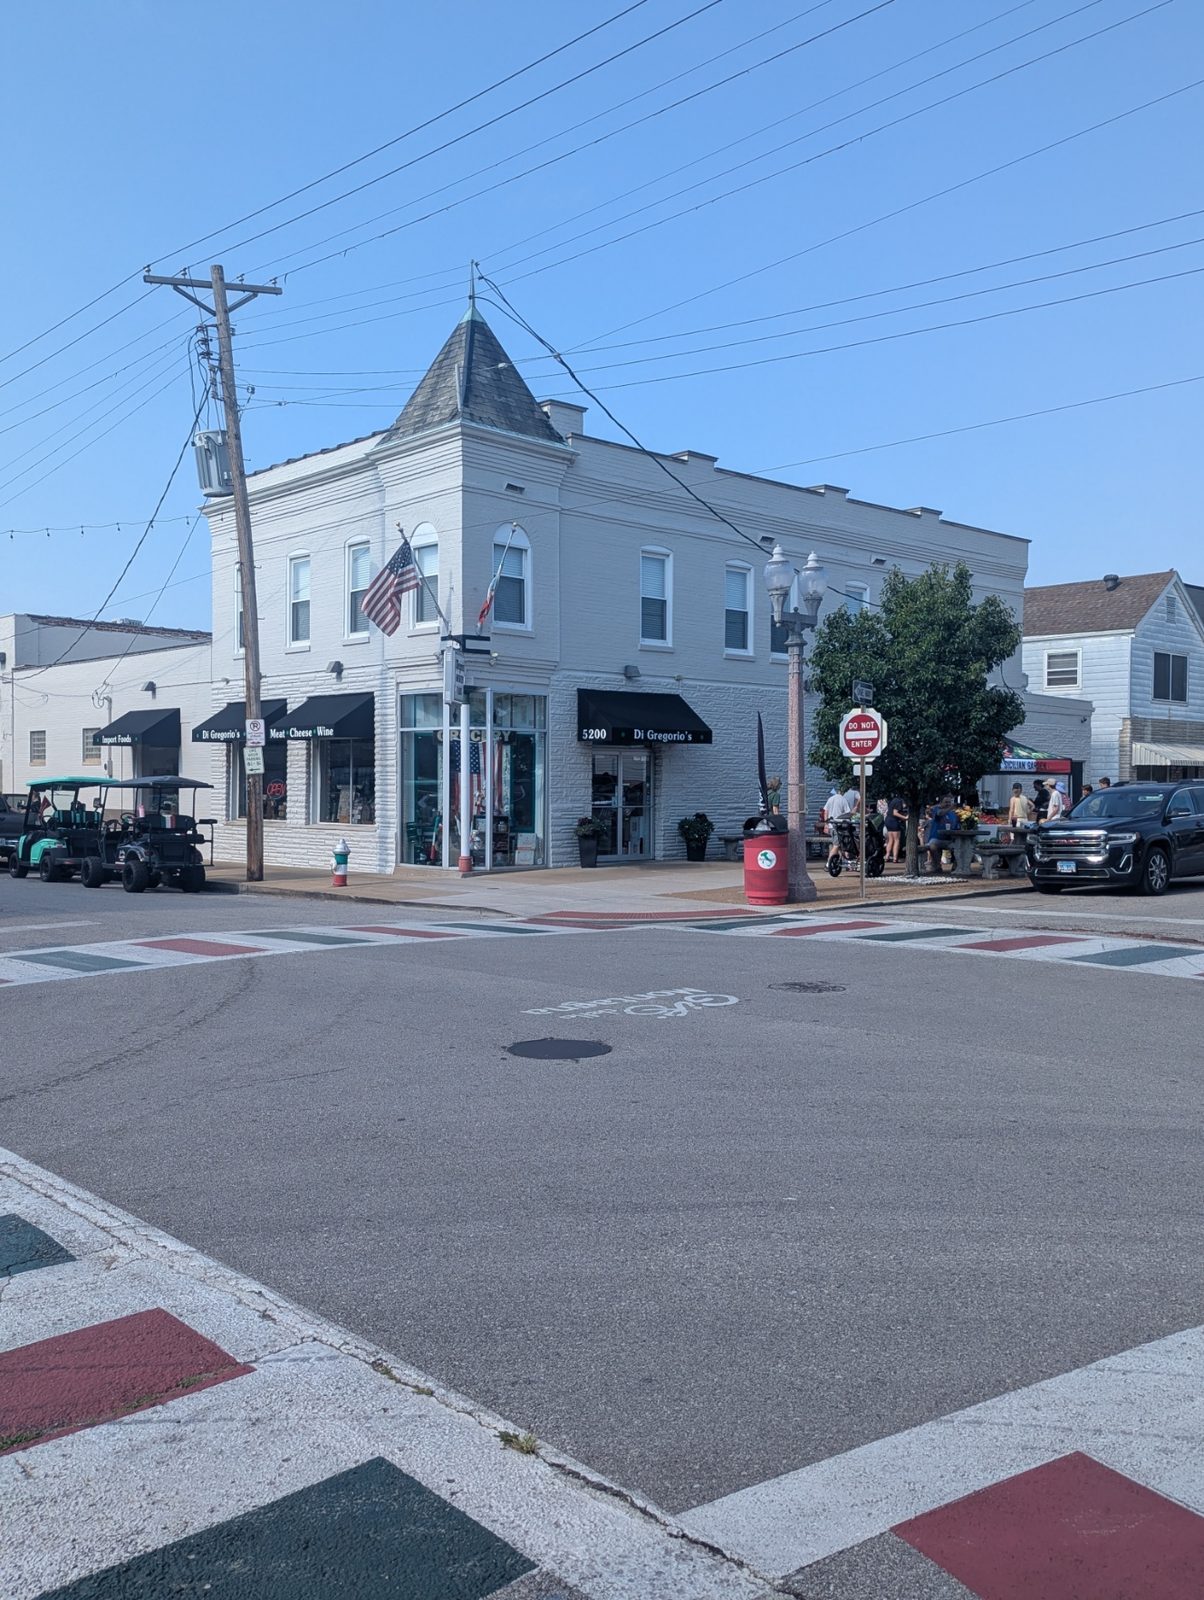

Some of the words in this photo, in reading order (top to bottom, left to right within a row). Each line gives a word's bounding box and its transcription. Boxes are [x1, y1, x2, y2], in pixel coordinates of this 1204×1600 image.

[848, 722, 858, 730] DO
[861, 721, 875, 729] NOT
[202, 730, 209, 739] Di
[210, 729, 240, 740] Gregorio's
[269, 729, 285, 738] Meat
[289, 728, 312, 738] Cheese
[316, 726, 334, 736] Wine
[582, 729, 607, 739] 5200
[633, 729, 644, 739] Di
[647, 730, 692, 742] Gregorio's
[117, 733, 132, 743] Foods
[851, 740, 873, 748] ENTER
[1003, 760, 1026, 770] SICILIAN
